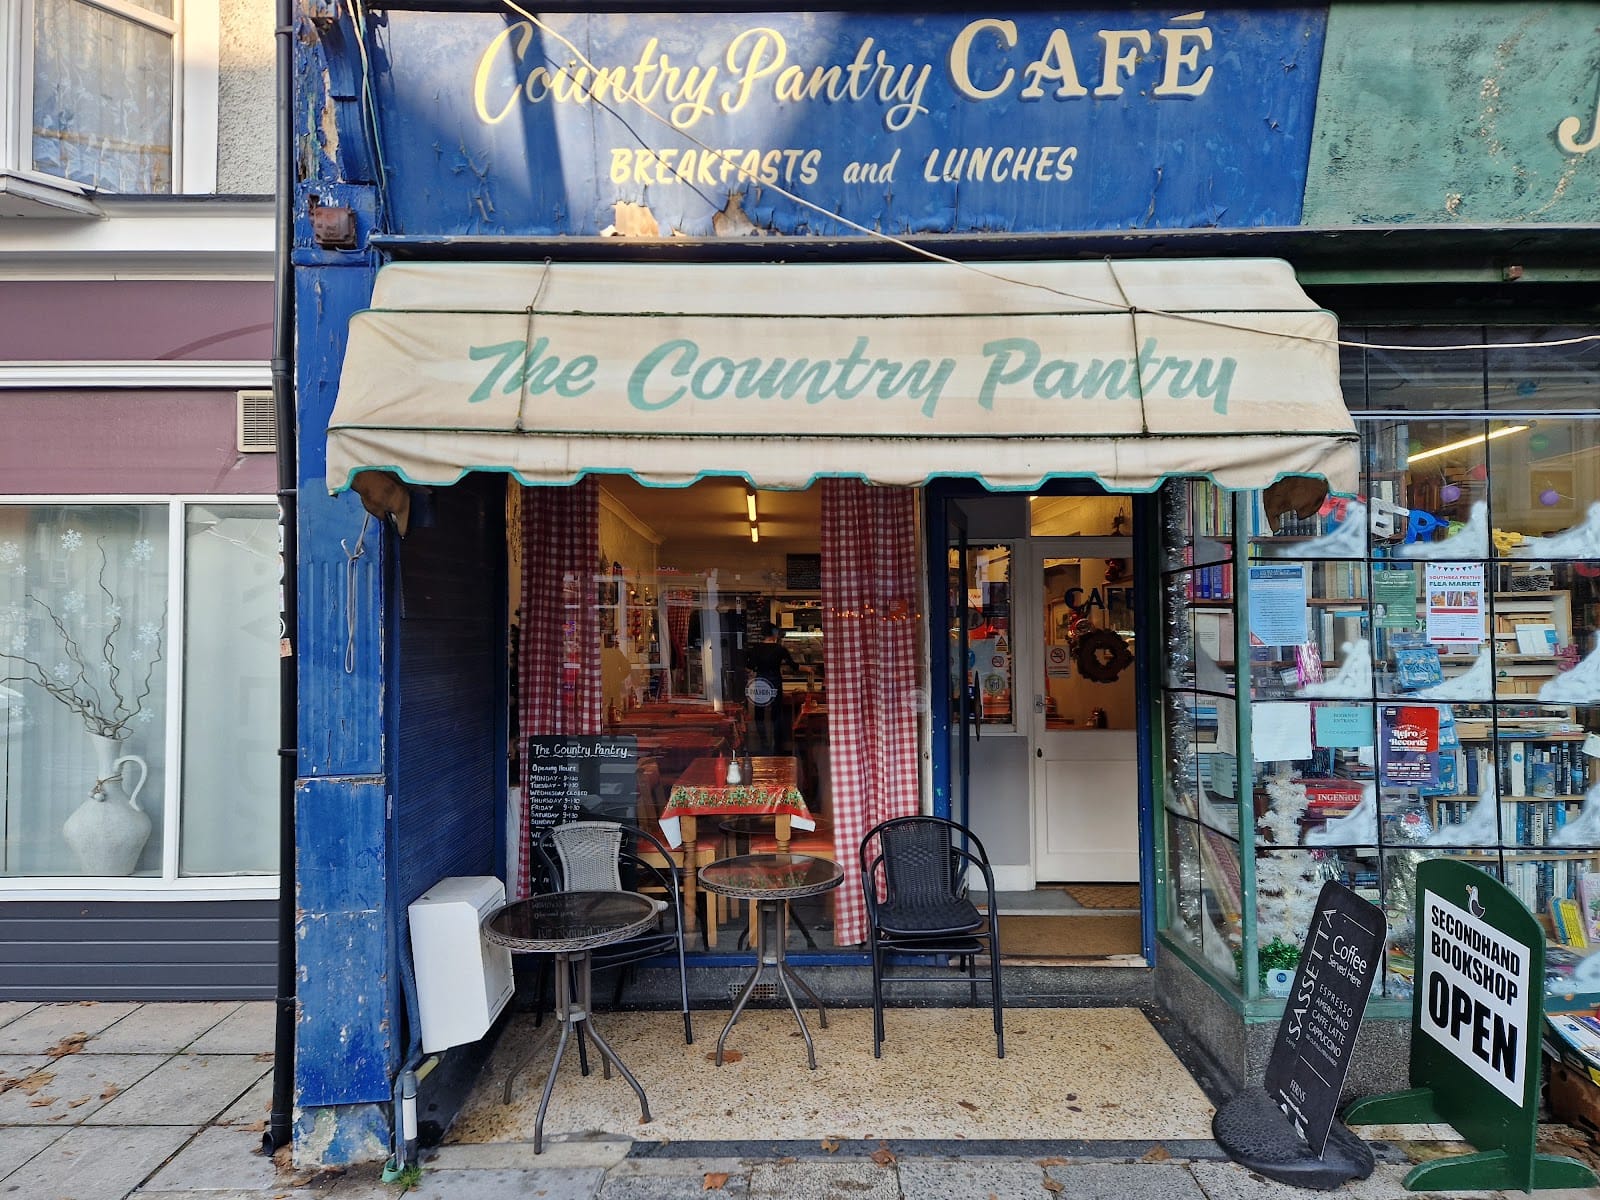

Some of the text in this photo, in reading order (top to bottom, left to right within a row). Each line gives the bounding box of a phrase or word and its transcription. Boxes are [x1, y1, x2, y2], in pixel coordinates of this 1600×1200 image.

[474, 10, 1214, 131] Country Pantry CAFÉ
[609, 146, 1078, 186] BREAKFASTS and LUNCHES
[467, 335, 1237, 418] The Country Pantry
[554, 744, 590, 757] Country
[594, 743, 628, 758] Pantry
[1333, 935, 1367, 974] Coffee
[1431, 904, 1520, 977] SECONDHAND
[1288, 908, 1337, 1041] SASSETTA
[1328, 954, 1362, 988] Served Here
[1431, 930, 1518, 1006] BOOKSHOP
[1316, 997, 1349, 1031] AMERICANO
[1320, 984, 1353, 1018] ESPRESSO
[1308, 1022, 1342, 1058] CAPPUCCINO
[1328, 1024, 1346, 1045] LATTE
[1428, 970, 1518, 1084] OPEN
